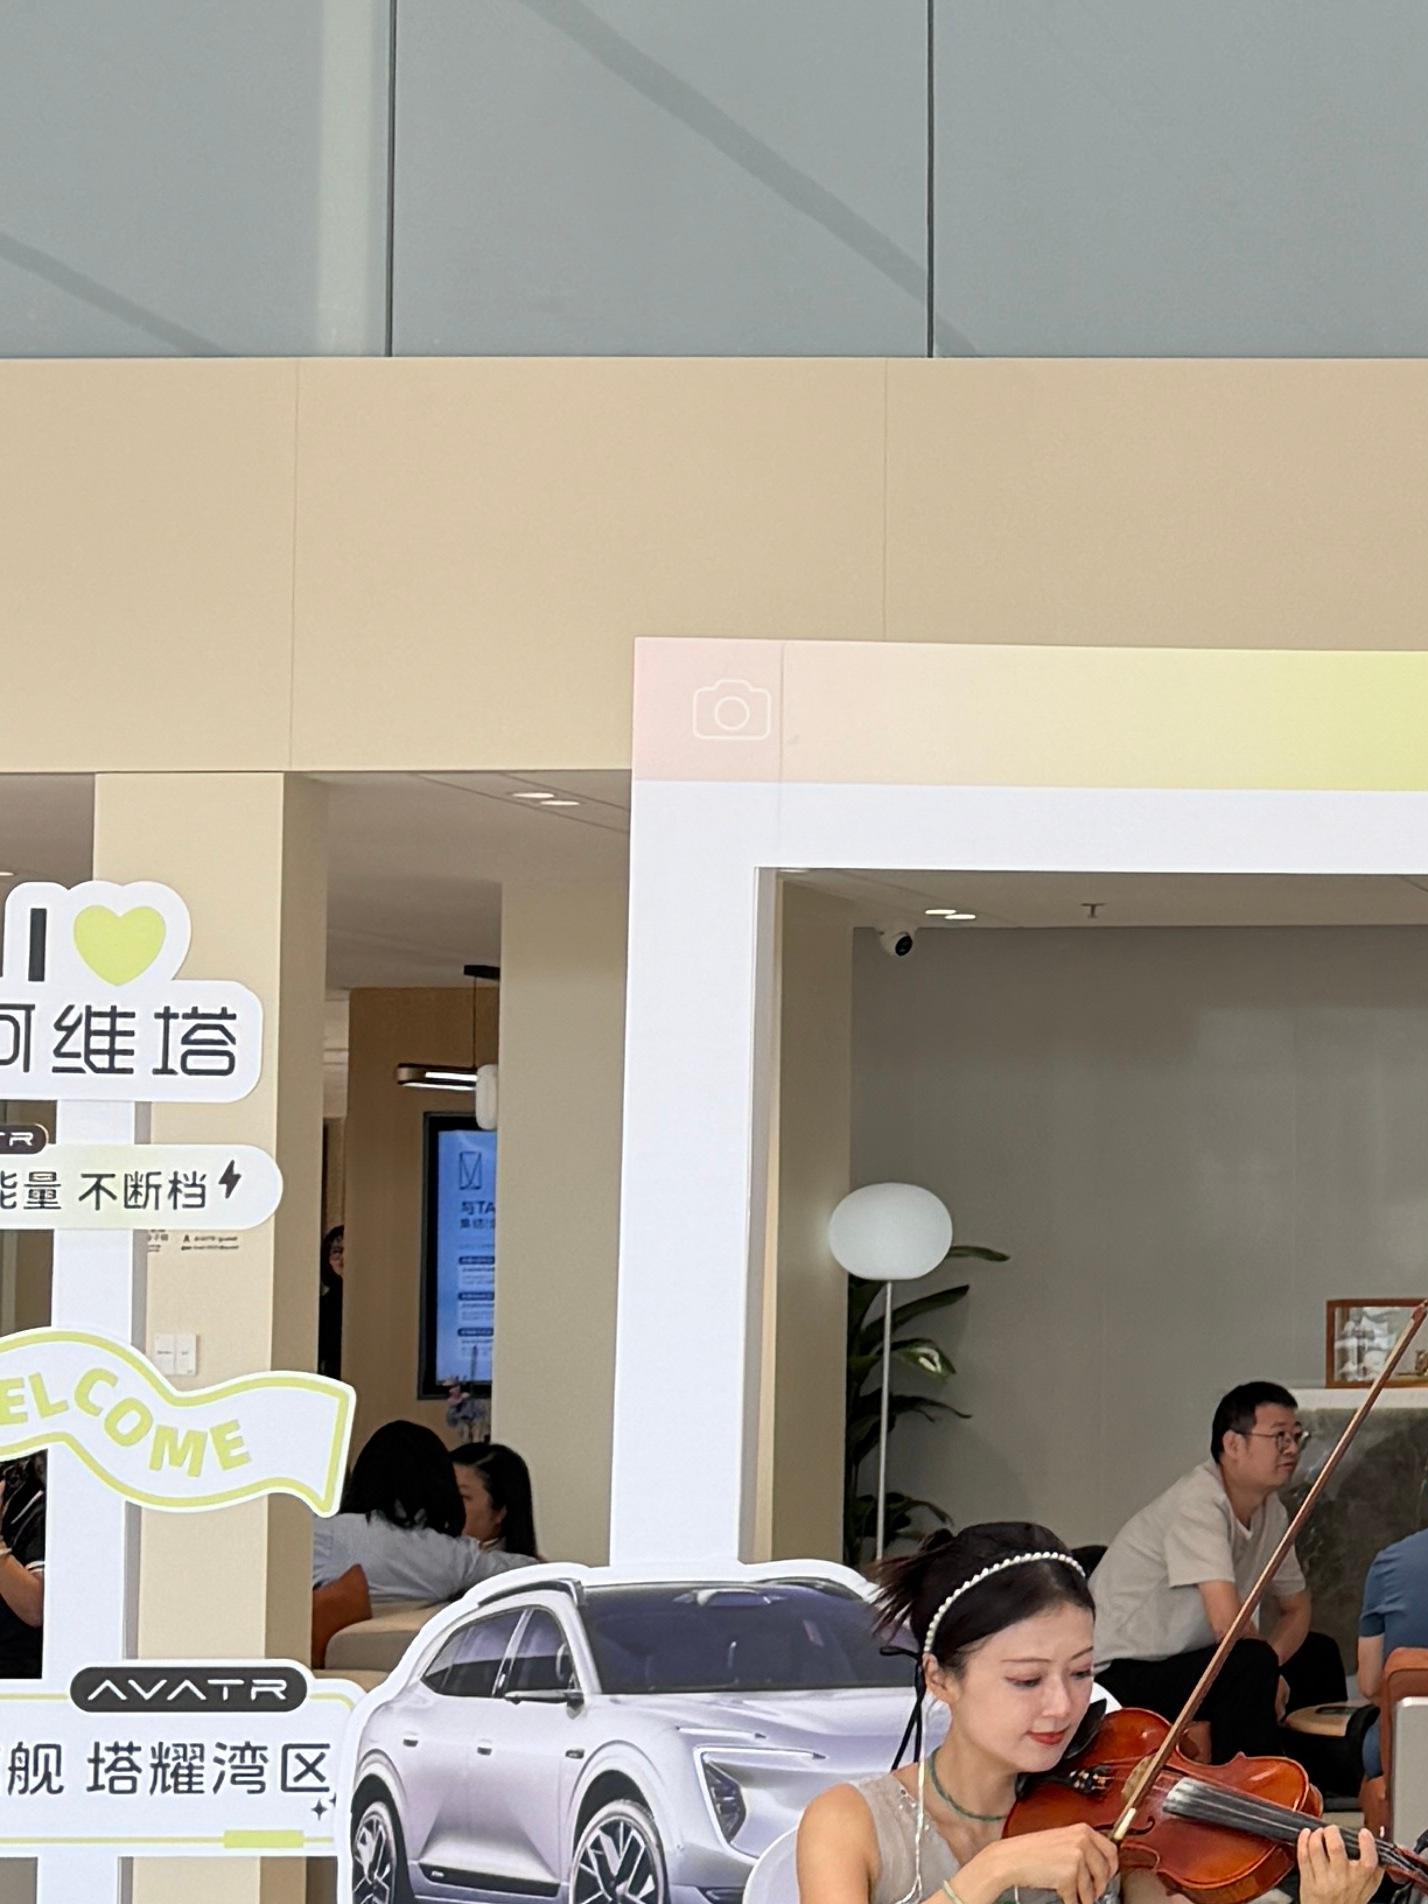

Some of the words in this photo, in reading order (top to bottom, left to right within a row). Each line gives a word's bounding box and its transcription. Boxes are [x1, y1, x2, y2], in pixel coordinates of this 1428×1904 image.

[78, 1170, 207, 1211] 不断档
[0, 1367, 251, 1478] ELCOME
[88, 1679, 288, 1701] AVATR
[8, 1741, 65, 1795] 舰
[86, 1741, 331, 1795] 塔耀湾区
